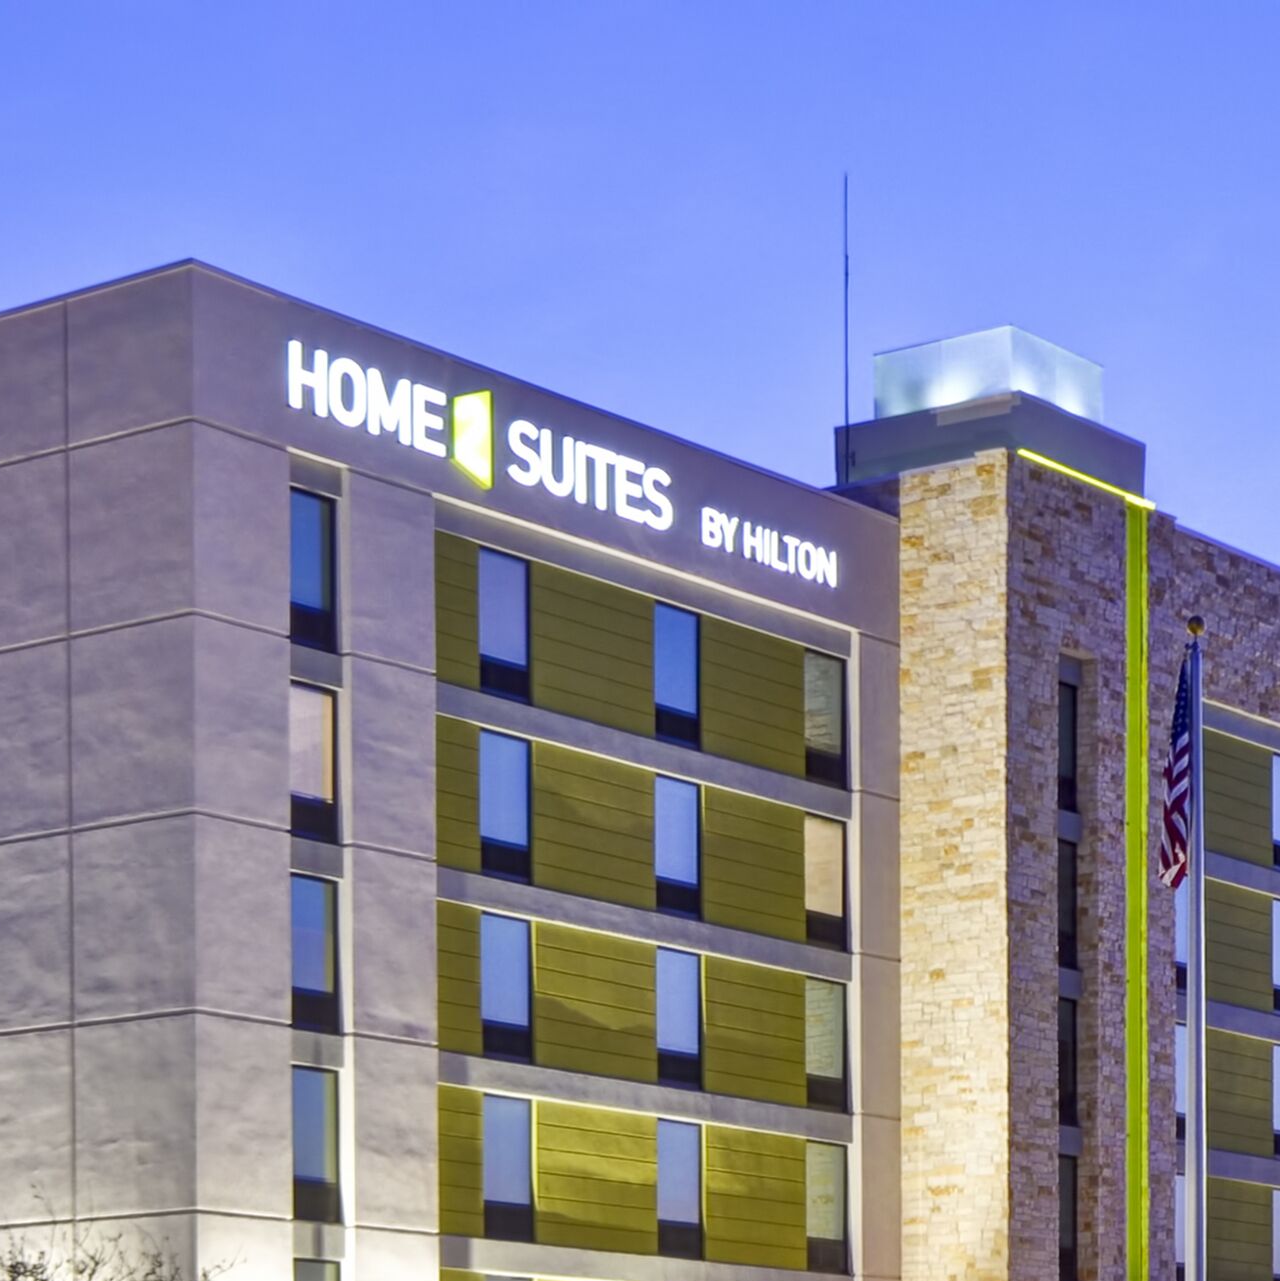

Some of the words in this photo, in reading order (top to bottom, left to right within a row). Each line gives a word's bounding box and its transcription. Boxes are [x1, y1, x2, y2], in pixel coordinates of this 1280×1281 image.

[286, 338, 448, 459] HOME
[506, 418, 675, 532] SUITES
[700, 505, 740, 553] BY
[742, 520, 838, 588] HILTON
